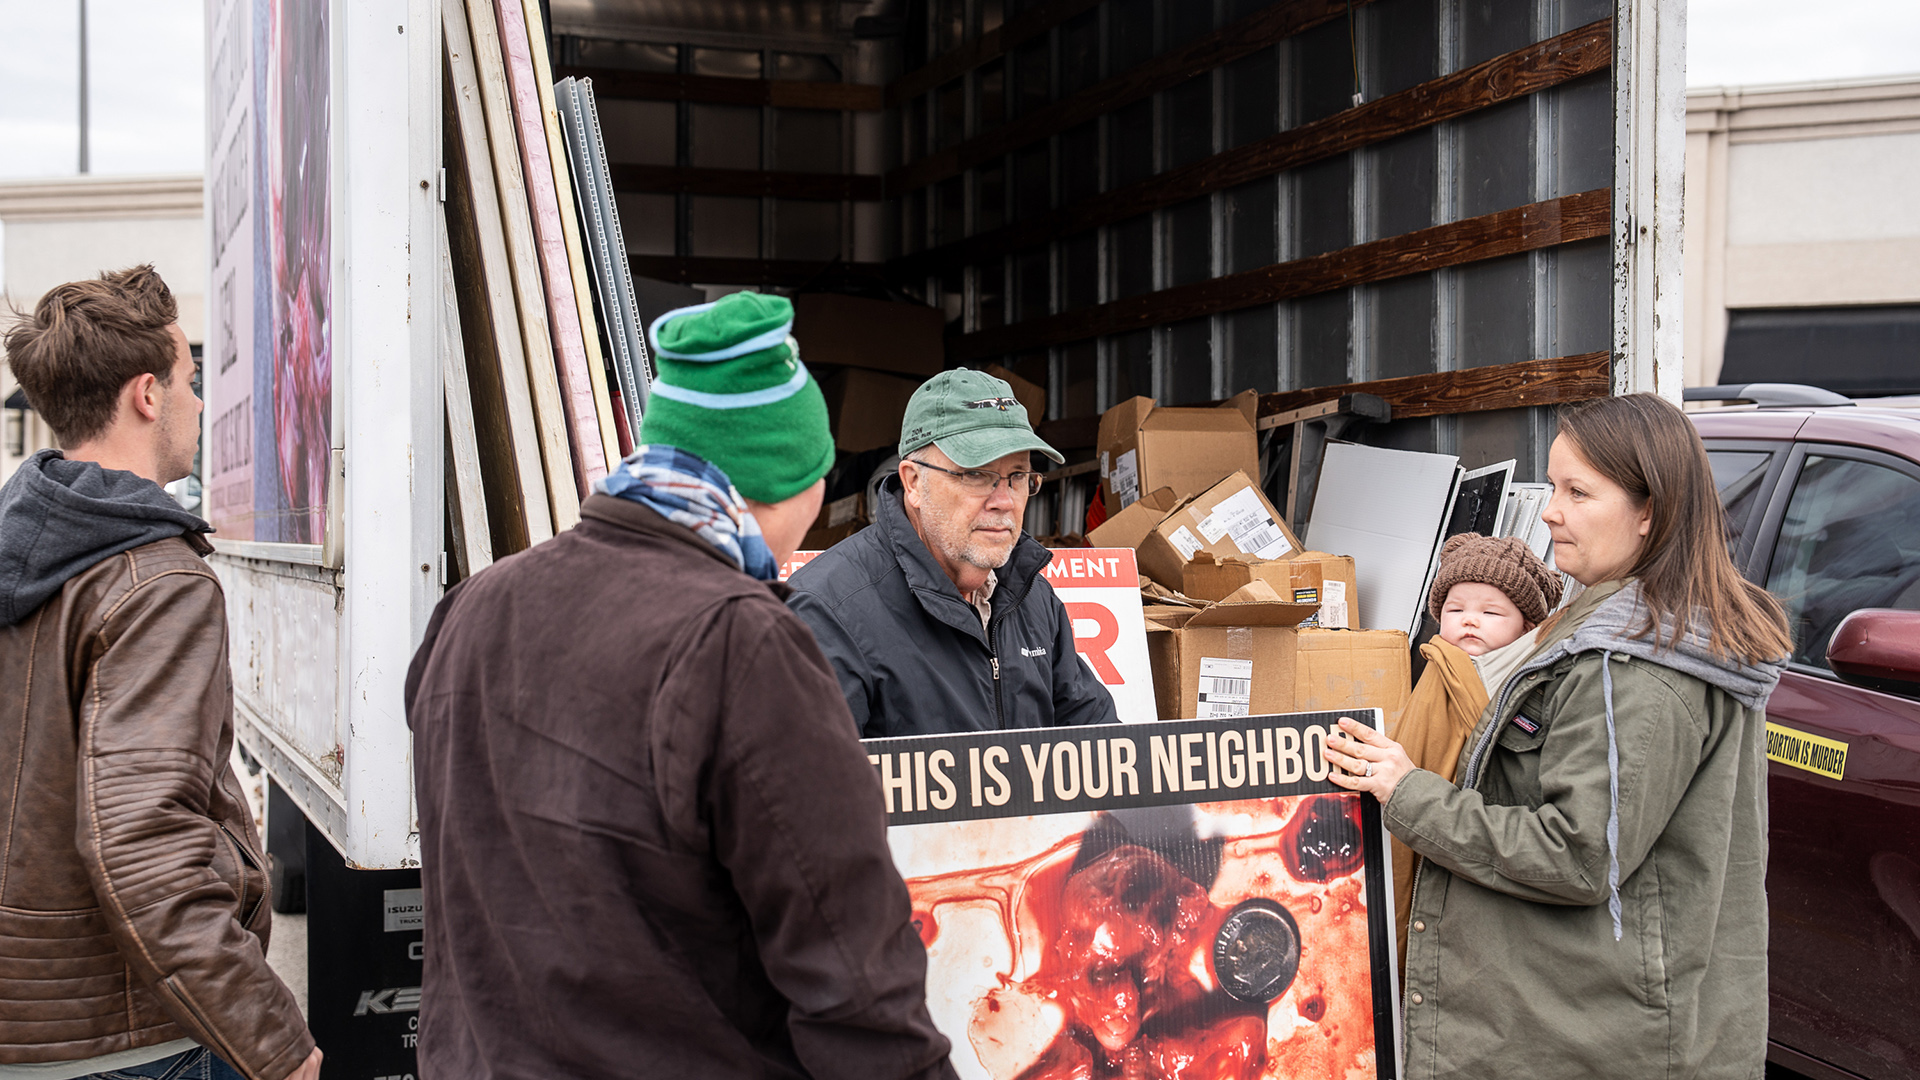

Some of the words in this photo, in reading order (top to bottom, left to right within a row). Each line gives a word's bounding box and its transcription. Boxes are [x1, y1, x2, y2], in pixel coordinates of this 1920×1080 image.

[1041, 557, 1120, 578] MENT
[1800, 740, 1811, 765] IS
[1809, 743, 1845, 775] MURDER
[867, 749, 958, 814] HIS
[970, 745, 1011, 808] IS
[1021, 737, 1139, 803] YOUR
[388, 905, 423, 913] ISUZU
[408, 1016, 421, 1030] C
